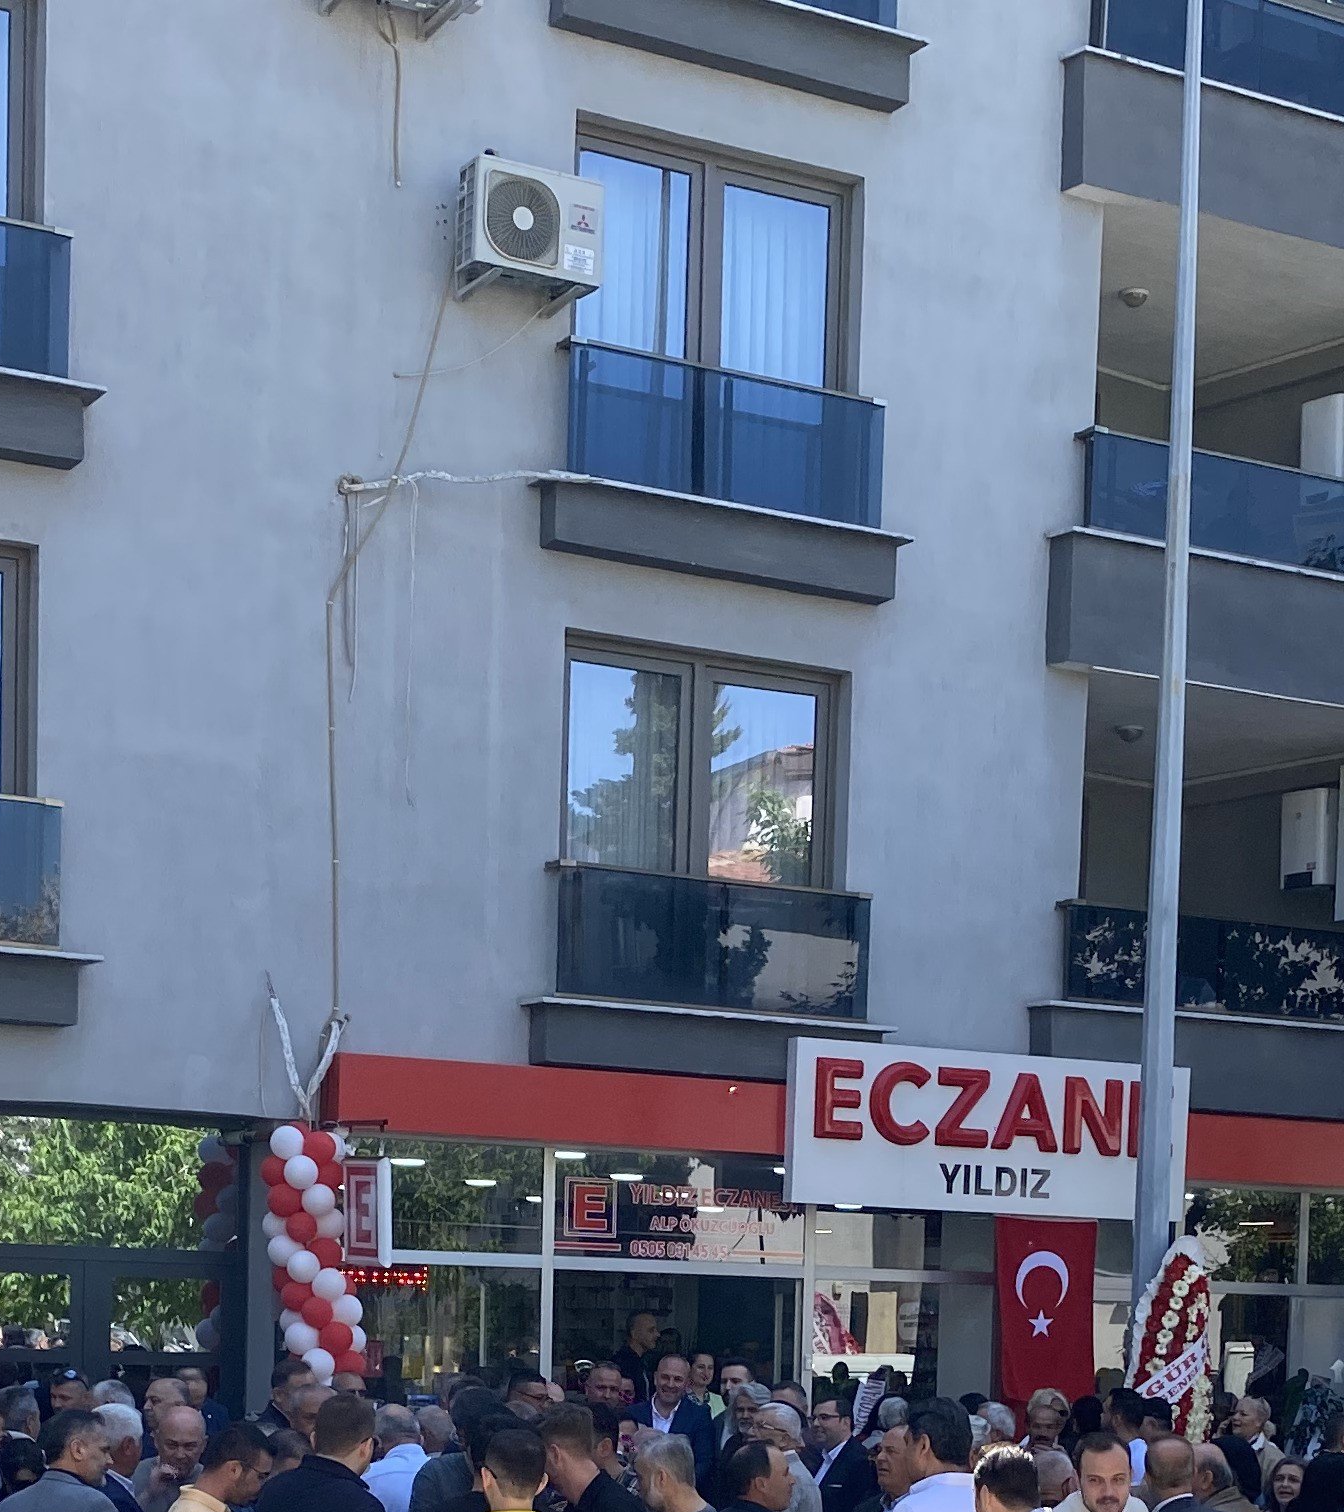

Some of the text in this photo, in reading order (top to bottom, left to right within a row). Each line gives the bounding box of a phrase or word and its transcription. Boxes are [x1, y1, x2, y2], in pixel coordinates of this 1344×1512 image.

[939, 1162, 1051, 1200] YILDIZ
[629, 1183, 698, 1207] YILDIZ
[650, 1215, 678, 1232] ALP
[630, 1240, 665, 1258] 0505
[1146, 1352, 1199, 1397] GÜR
